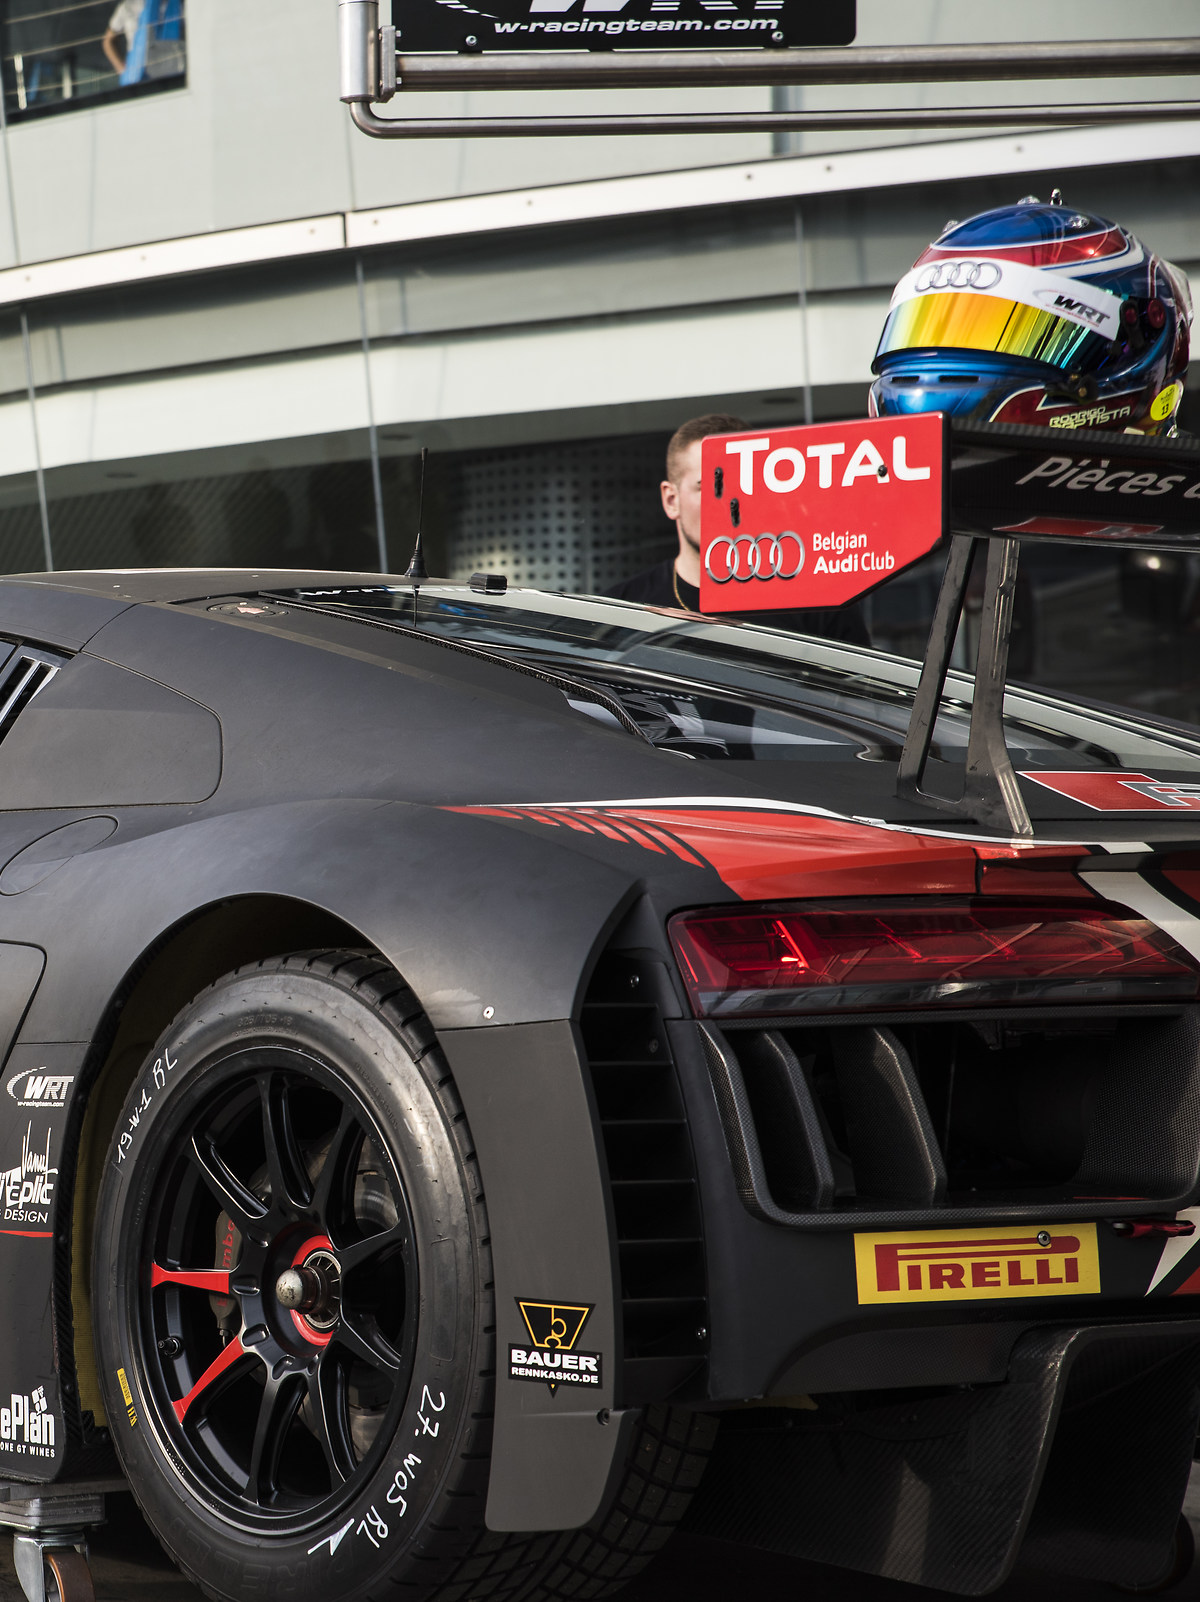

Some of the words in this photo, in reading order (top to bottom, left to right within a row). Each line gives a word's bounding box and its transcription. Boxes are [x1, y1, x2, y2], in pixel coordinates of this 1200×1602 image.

[493, 15, 779, 34] w-racingteam.com
[1053, 294, 1111, 325] WRT
[725, 436, 931, 495] TOTAL
[1015, 456, 1187, 496] Pièces
[813, 530, 868, 555] Belgian
[813, 554, 859, 575] Audi
[860, 551, 895, 571] Club
[23, 1075, 75, 1100] WRT
[3, 1208, 49, 1224] DESIGN
[874, 1235, 1081, 1292] PIRELLI
[511, 1348, 598, 1372] BAUER
[511, 1366, 599, 1384] RENNKASKO.DE
[16, 1443, 27, 1454] GT
[29, 1445, 56, 1458] WINES
